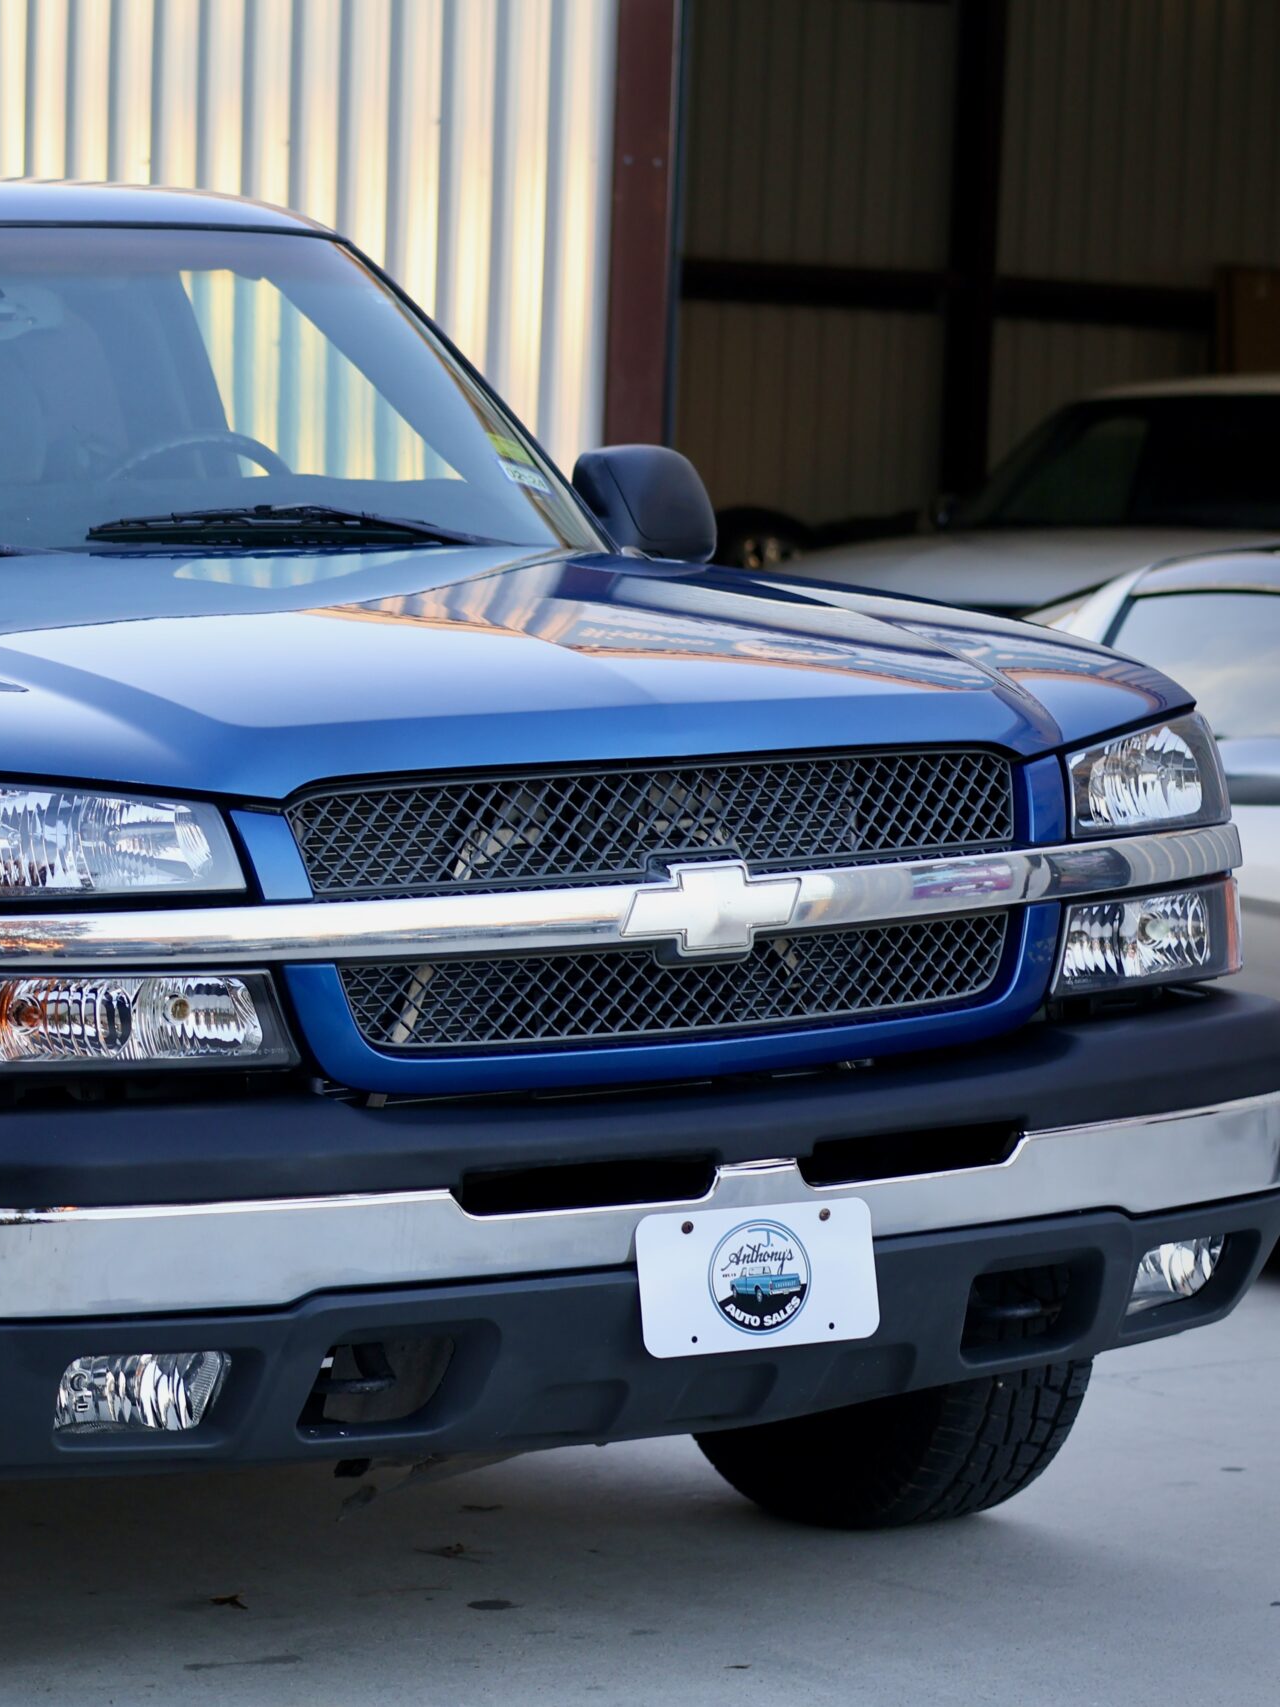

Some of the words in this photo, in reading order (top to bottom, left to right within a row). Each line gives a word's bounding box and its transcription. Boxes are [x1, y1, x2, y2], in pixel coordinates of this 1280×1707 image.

[721, 1243, 794, 1275] Anthony's
[726, 1304, 760, 1326] AUTO
[764, 1296, 800, 1326] SALES
